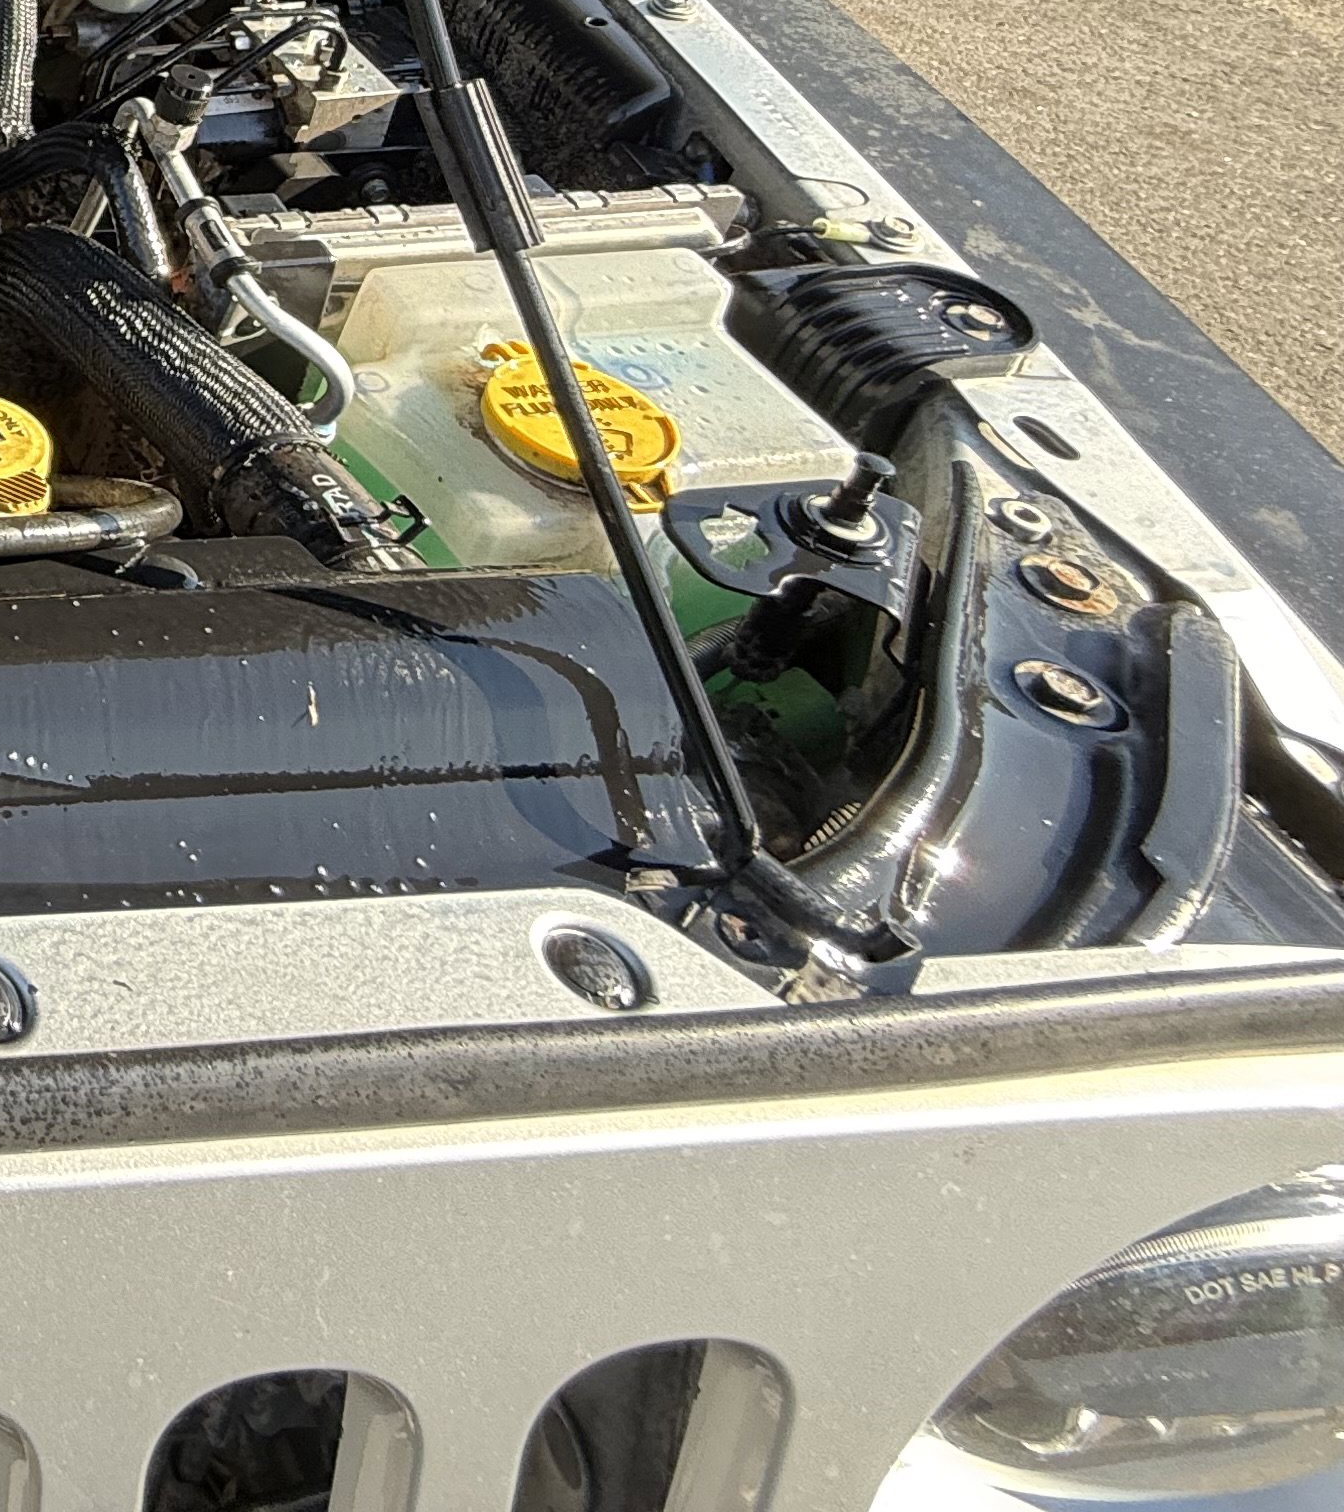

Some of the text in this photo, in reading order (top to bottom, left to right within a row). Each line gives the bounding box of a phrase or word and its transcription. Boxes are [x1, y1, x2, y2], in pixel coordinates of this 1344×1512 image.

[500, 379, 611, 399] WAER
[1184, 1276, 1235, 1305] DOT
[1238, 1268, 1290, 1293] SAE
